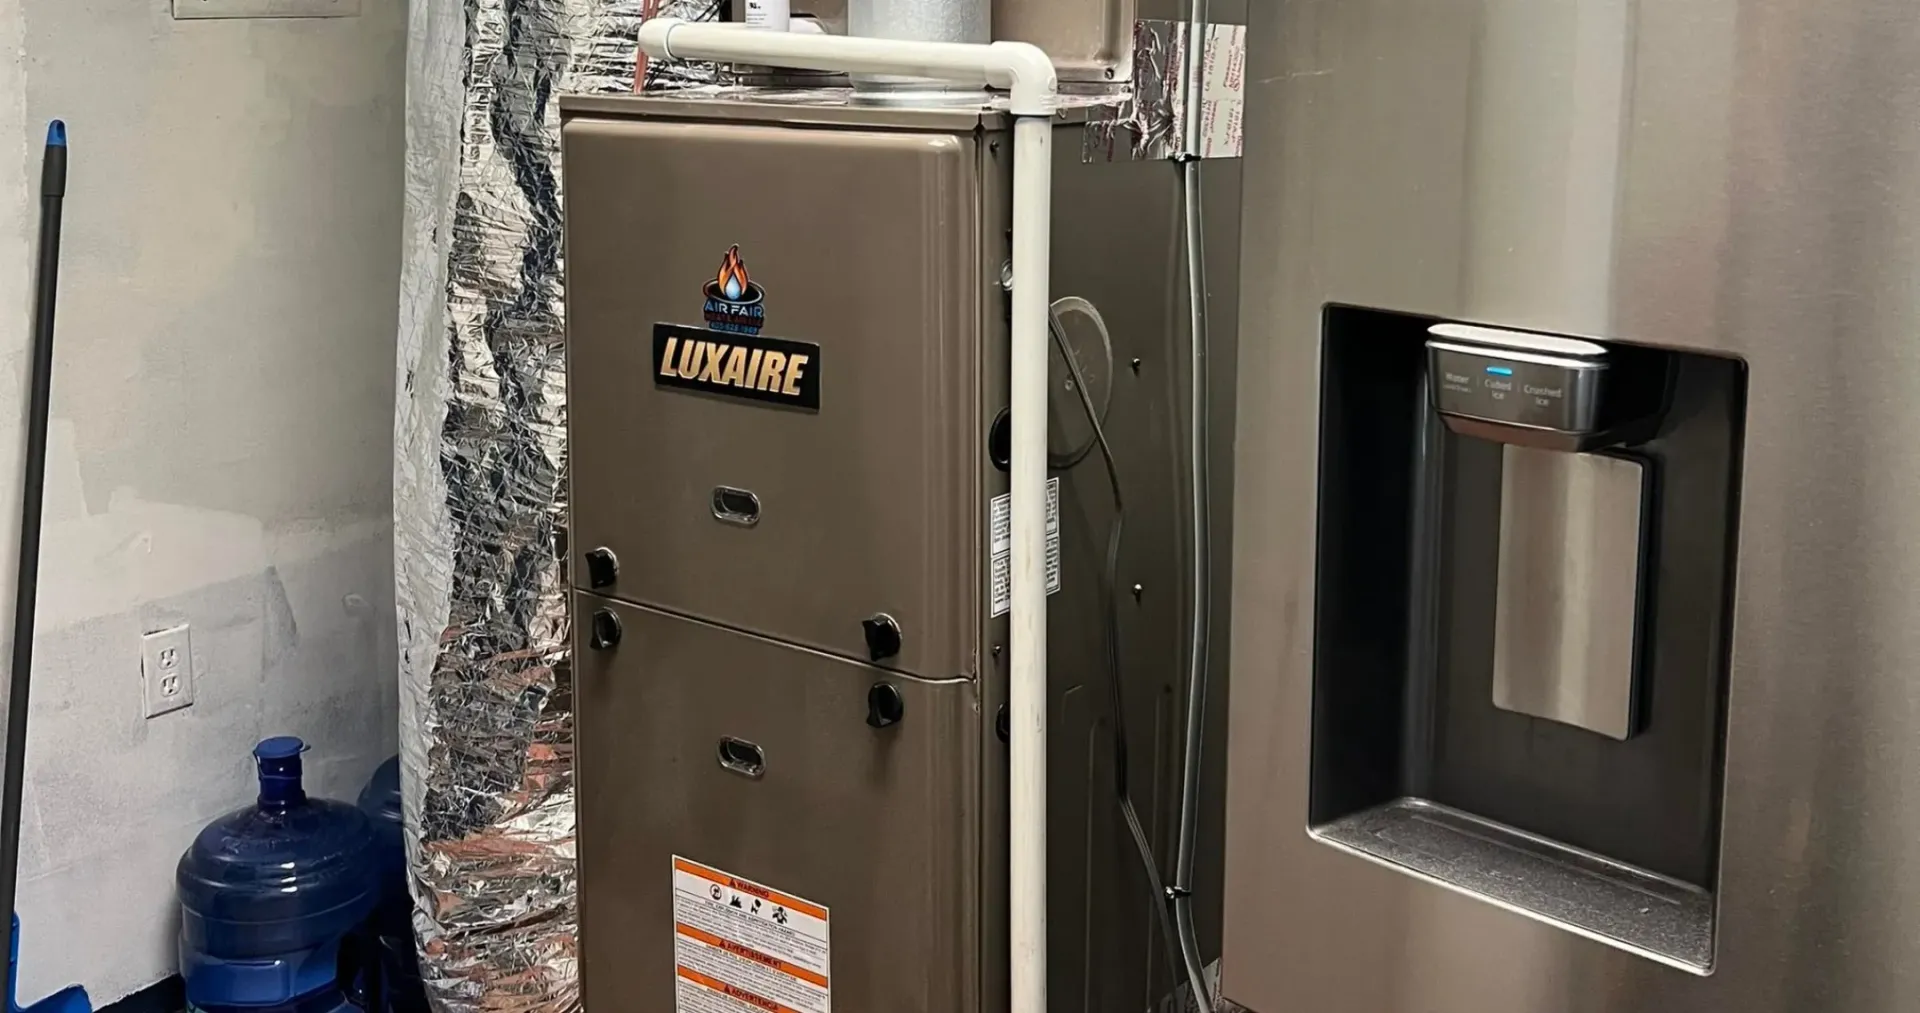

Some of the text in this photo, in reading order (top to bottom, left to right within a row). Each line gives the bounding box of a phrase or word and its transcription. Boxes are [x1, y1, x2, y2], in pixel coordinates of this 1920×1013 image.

[705, 301, 763, 318] AIR FAIR
[660, 337, 809, 396] LUXAIRE
[1485, 379, 1512, 391] Cubed
[1524, 384, 1563, 398] Crushed
[738, 882, 769, 898] WARNING
